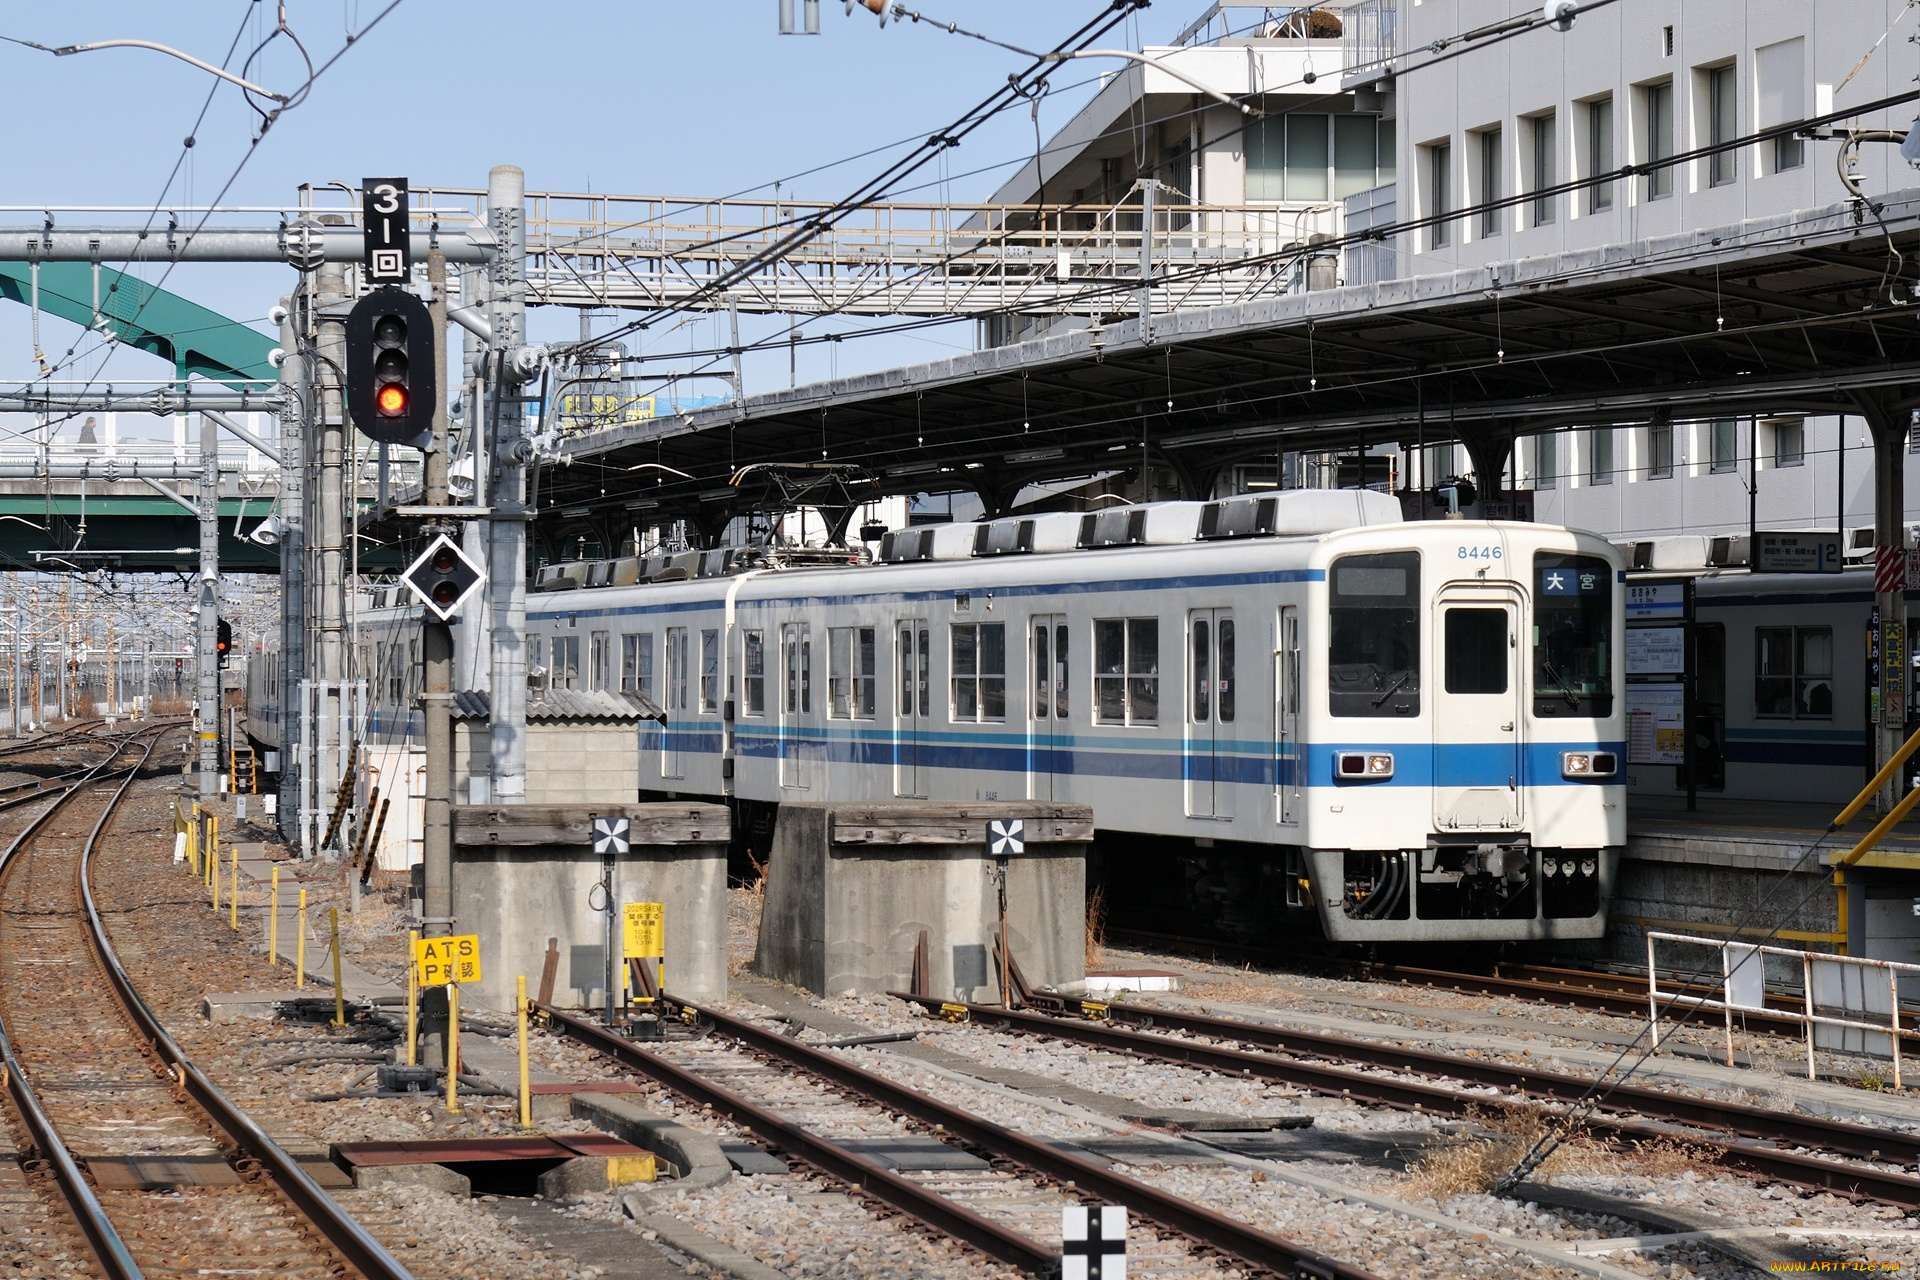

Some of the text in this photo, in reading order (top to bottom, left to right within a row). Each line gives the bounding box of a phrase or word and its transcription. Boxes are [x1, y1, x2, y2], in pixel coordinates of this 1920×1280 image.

[1457, 546, 1502, 559] 8446
[1826, 543, 1837, 562] 2
[1547, 572, 1596, 590] 大宮
[424, 940, 473, 960] ATS
